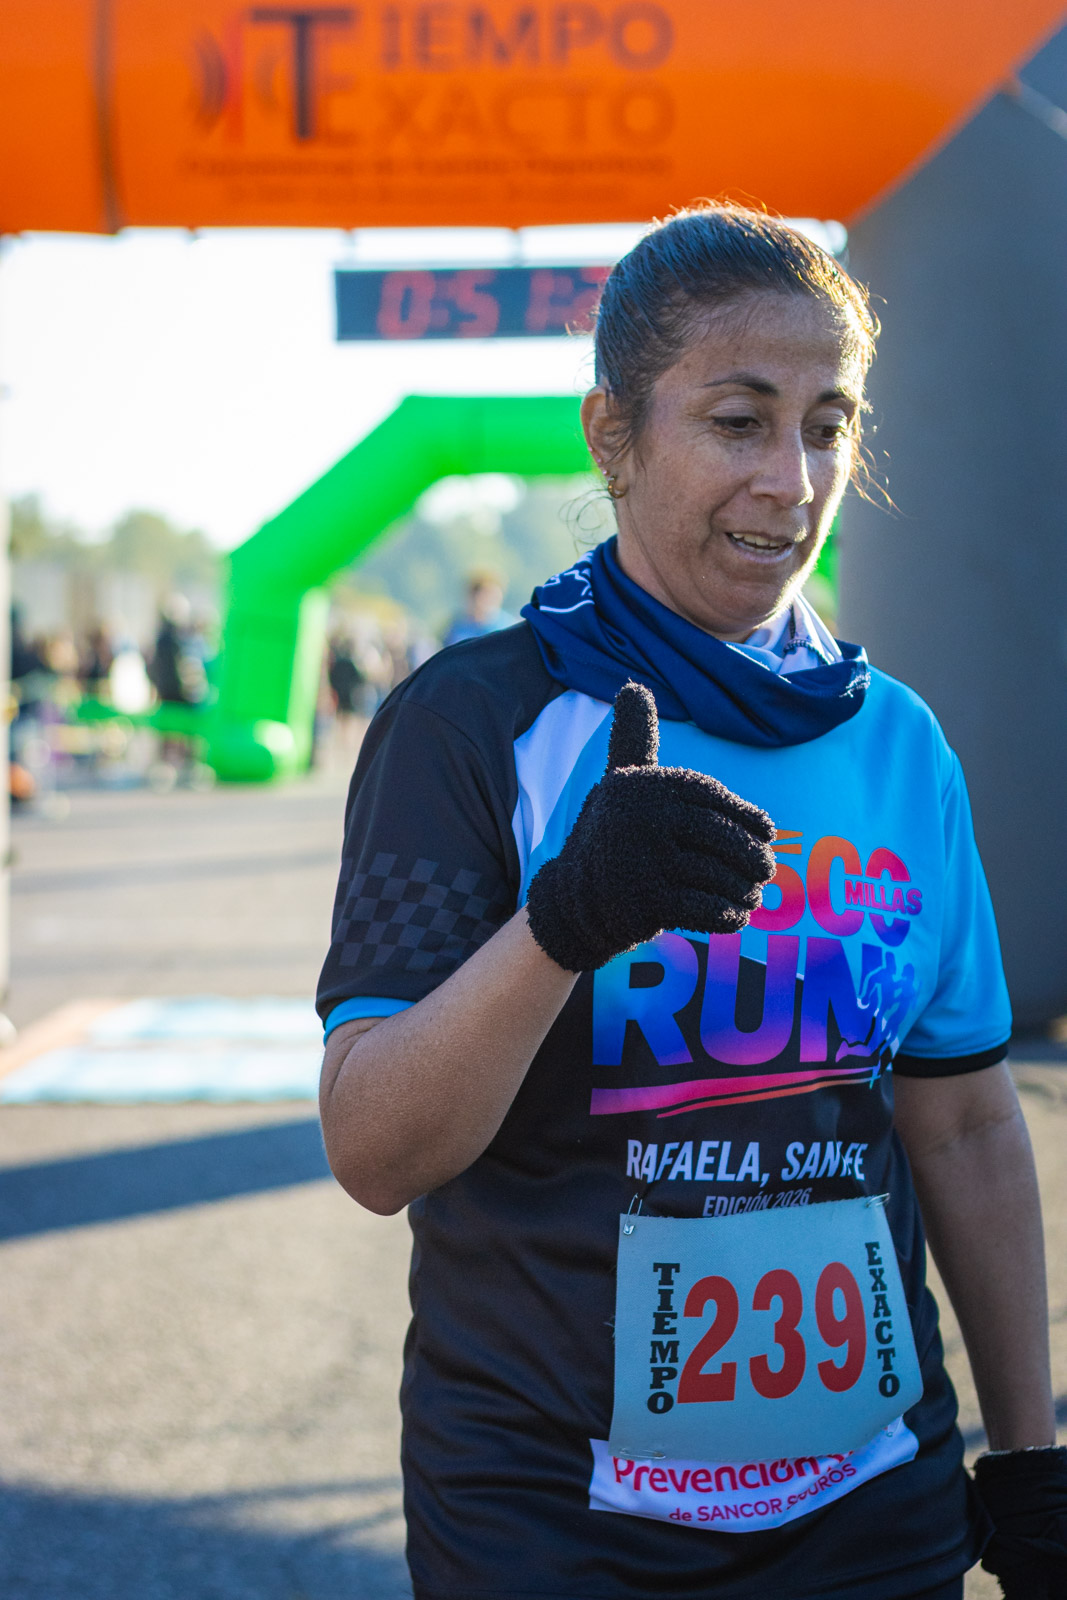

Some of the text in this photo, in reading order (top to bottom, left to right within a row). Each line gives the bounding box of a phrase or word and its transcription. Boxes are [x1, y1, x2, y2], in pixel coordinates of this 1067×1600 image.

[844, 878, 923, 916] MILLAS
[592, 931, 886, 1066] RUN
[625, 1139, 770, 1188] RAFAELA,
[702, 1187, 813, 1217] EDICIÓN 2026
[646, 1262, 680, 1414] TIEMPO
[676, 1261, 867, 1404] 239
[864, 1241, 900, 1398] EXACTO
[612, 1456, 820, 1493] Prevención
[668, 1508, 692, 1521] de
[697, 1498, 782, 1522] SANCOR
